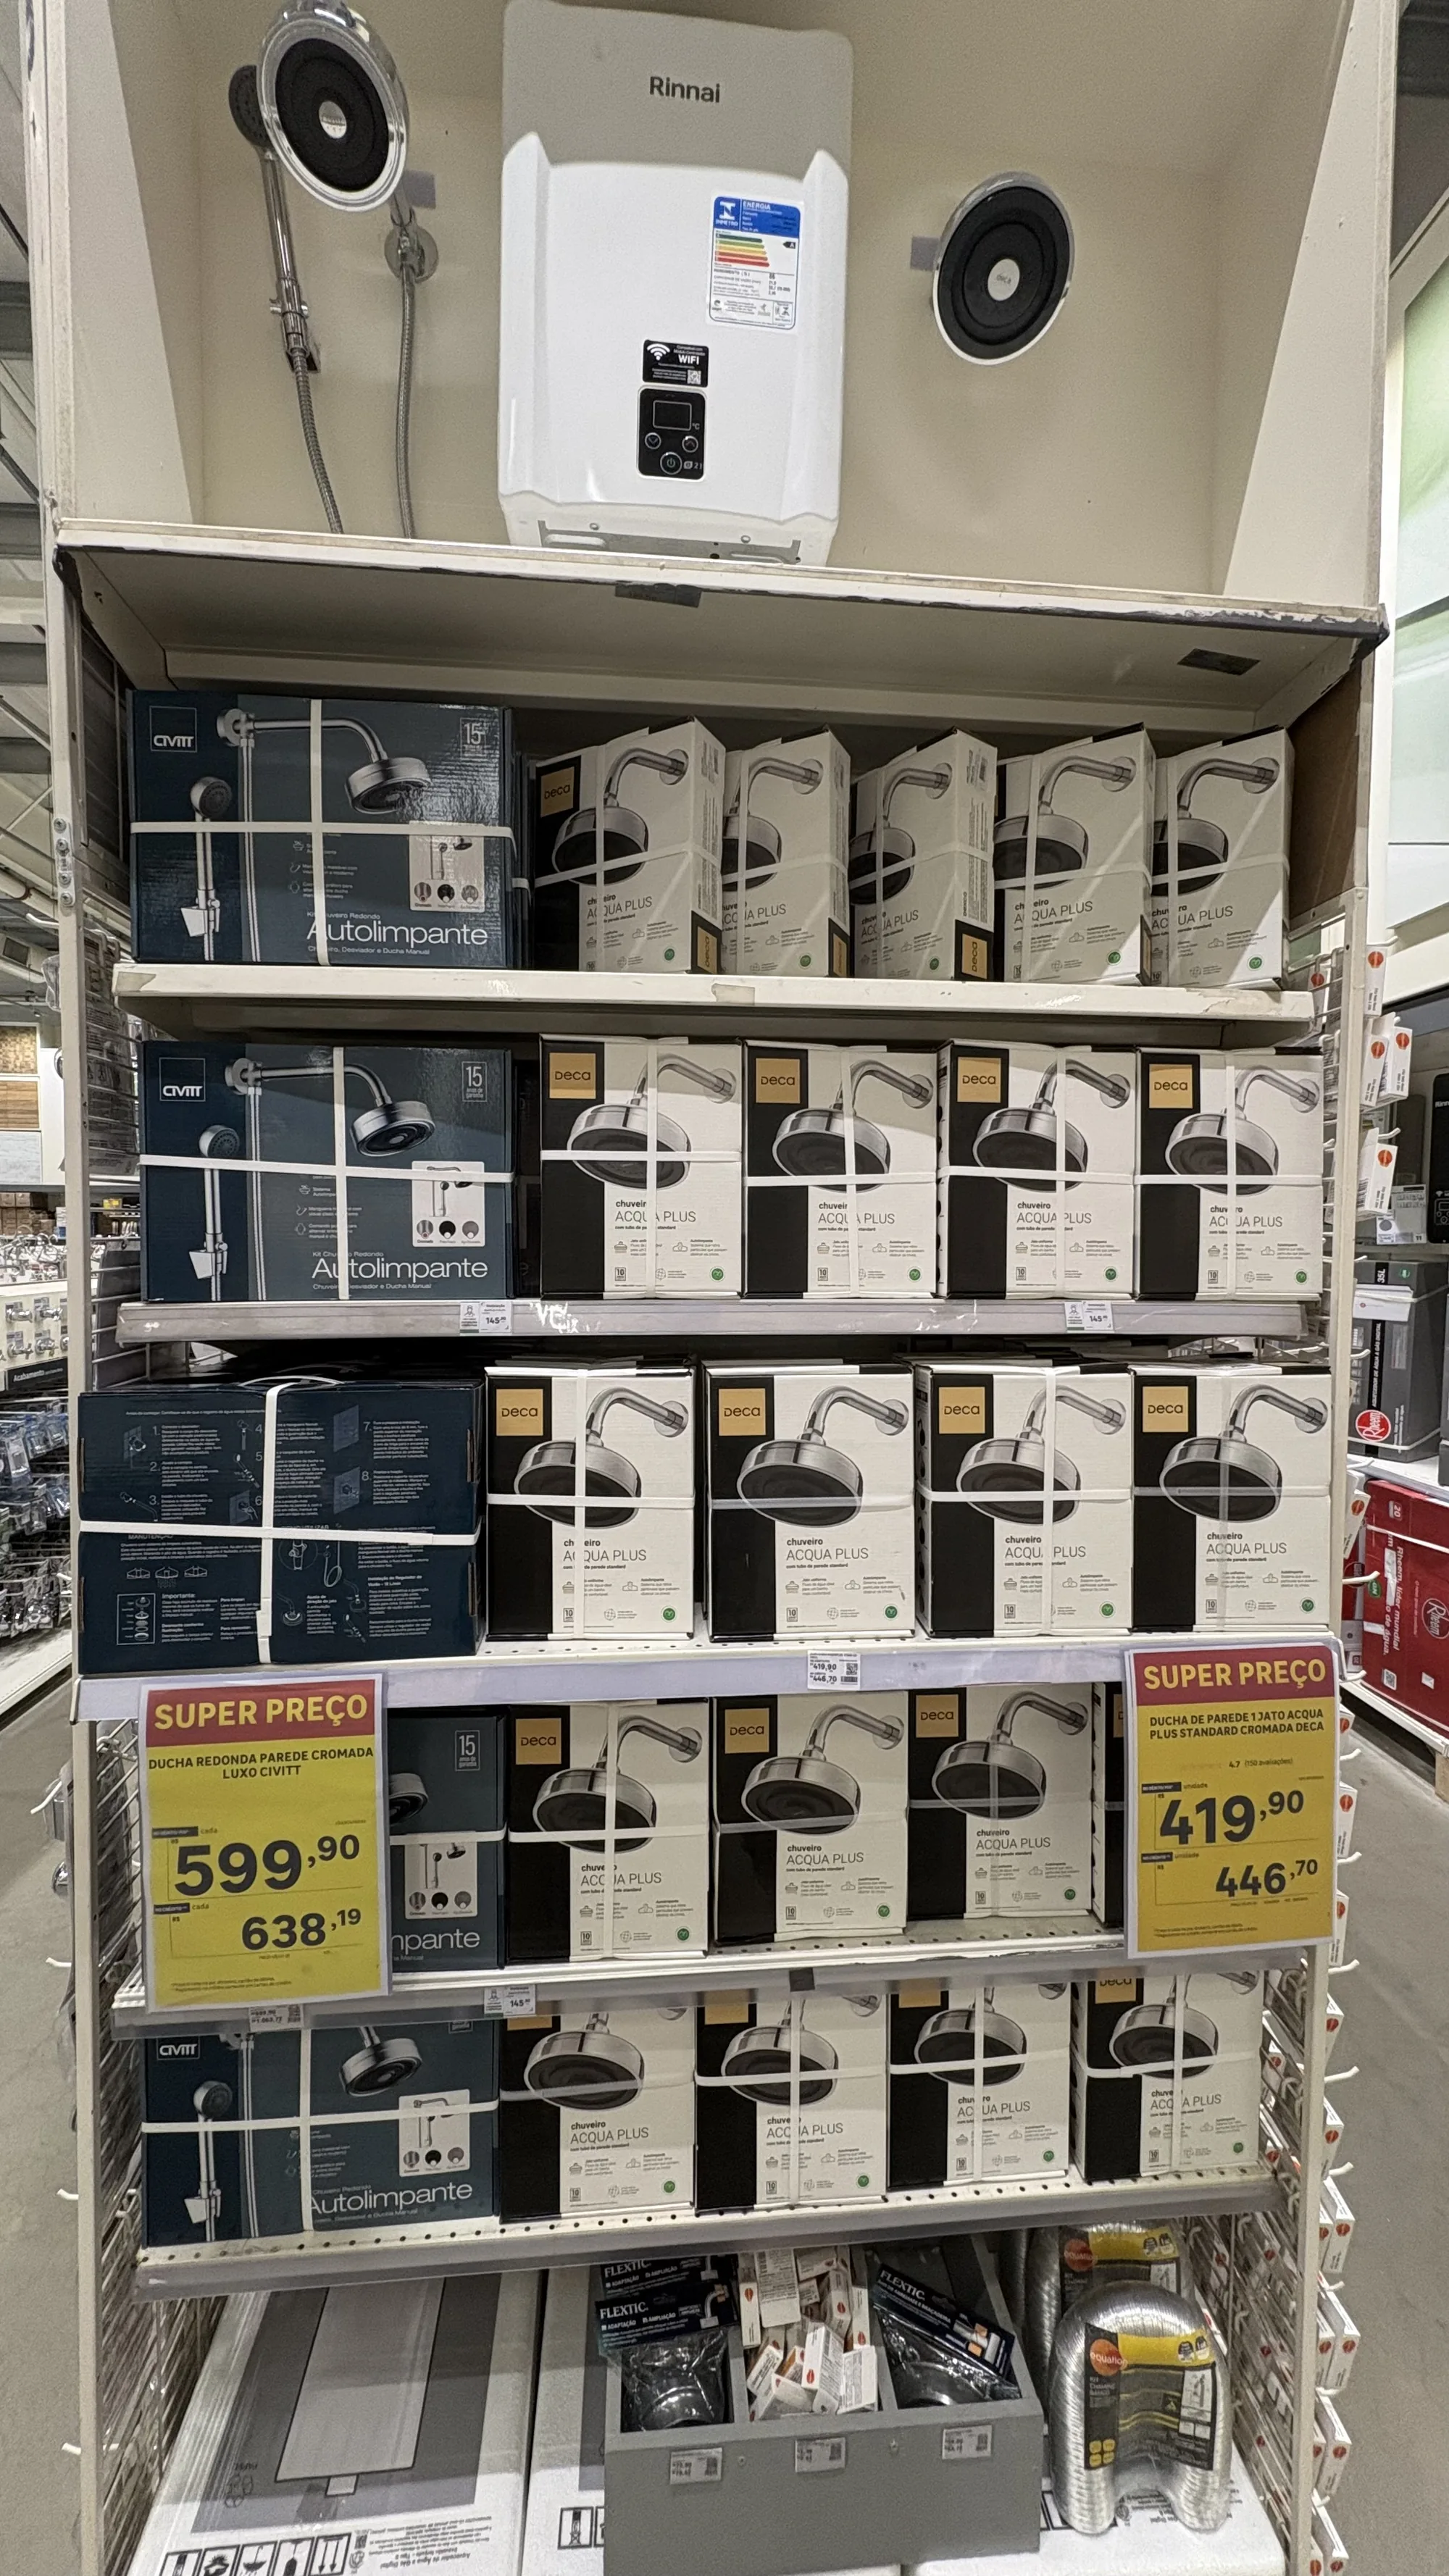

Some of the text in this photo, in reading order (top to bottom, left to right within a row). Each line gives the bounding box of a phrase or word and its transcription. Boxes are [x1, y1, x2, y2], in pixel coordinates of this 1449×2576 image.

[649, 75, 721, 104] Rinnai
[678, 354, 700, 365] WIFI
[464, 722, 481, 745] 15
[625, 896, 653, 911] PLUS
[758, 903, 786, 917] PLUS
[1060, 901, 1093, 916] PLUS
[893, 910, 919, 927] PLUS
[1199, 906, 1232, 921] PLUS
[465, 1066, 483, 1087] 15
[554, 1071, 590, 1081] Deca
[761, 1076, 796, 1086] Deca
[962, 1074, 995, 1084] Deca
[1154, 1082, 1188, 1090] Deca
[616, 1200, 647, 1208] chuveir
[664, 1211, 696, 1222] PLUS
[864, 1213, 895, 1224] PLUS
[1016, 1213, 1092, 1225] ACQUA PLUS
[1253, 1216, 1283, 1227] PLUS
[501, 1407, 538, 1417] Deca
[724, 1407, 761, 1417] Deca
[943, 1405, 980, 1415] Deca
[1148, 1404, 1183, 1414] Deca
[1362, 1412, 1385, 1439] Rheem
[1394, 1505, 1401, 1518] 20
[613, 1550, 647, 1560] PLUS
[786, 1547, 869, 1561] ACQUA PLUS
[1005, 1546, 1086, 1559] ACQU PLUS
[1206, 1542, 1287, 1556] ACQUA PLUS
[1395, 1546, 1404, 1583] Rheem,
[1428, 1599, 1448, 1636] Rheem
[1144, 1658, 1326, 1690] SUPER PREÇO
[154, 1694, 367, 1730] SUPER PREÇO
[920, 1711, 954, 1721] Deca
[1150, 1708, 1324, 1727] DUCHA DE PAREDE 1 JATO ACQUA
[730, 1725, 764, 1736] Deca
[1150, 1721, 1324, 1739] PLUS STANDARD CROMADA DECA
[459, 1735, 476, 1756] 15
[521, 1736, 556, 1746] Deca
[149, 1747, 374, 1770] DUCHA REDONDA PAREDE CROMADA
[222, 1765, 302, 1780] LUXO CIVITT
[1160, 1790, 1304, 1845] 419,90
[976, 1837, 1051, 1851] ACQUA PLUS
[175, 1834, 360, 1897] 599,90
[786, 1852, 864, 1866] ACQUA PLUS
[629, 1872, 661, 1884] PLUS
[1216, 1859, 1318, 1897] 446,70
[241, 1908, 362, 1951] 638,19
[1001, 2101, 1030, 2113] PLUS
[1193, 2094, 1222, 2106] PLUS
[571, 2120, 606, 2130] chuveiro
[812, 2123, 843, 2136] PLUS
[570, 2127, 649, 2144] ACQUA PLUS
[604, 2259, 651, 2278] FLEXTIC
[880, 2270, 925, 2301] FLEXTIC
[600, 2301, 648, 2320] FLEXTIC
[1090, 2352, 1127, 2367] equation
